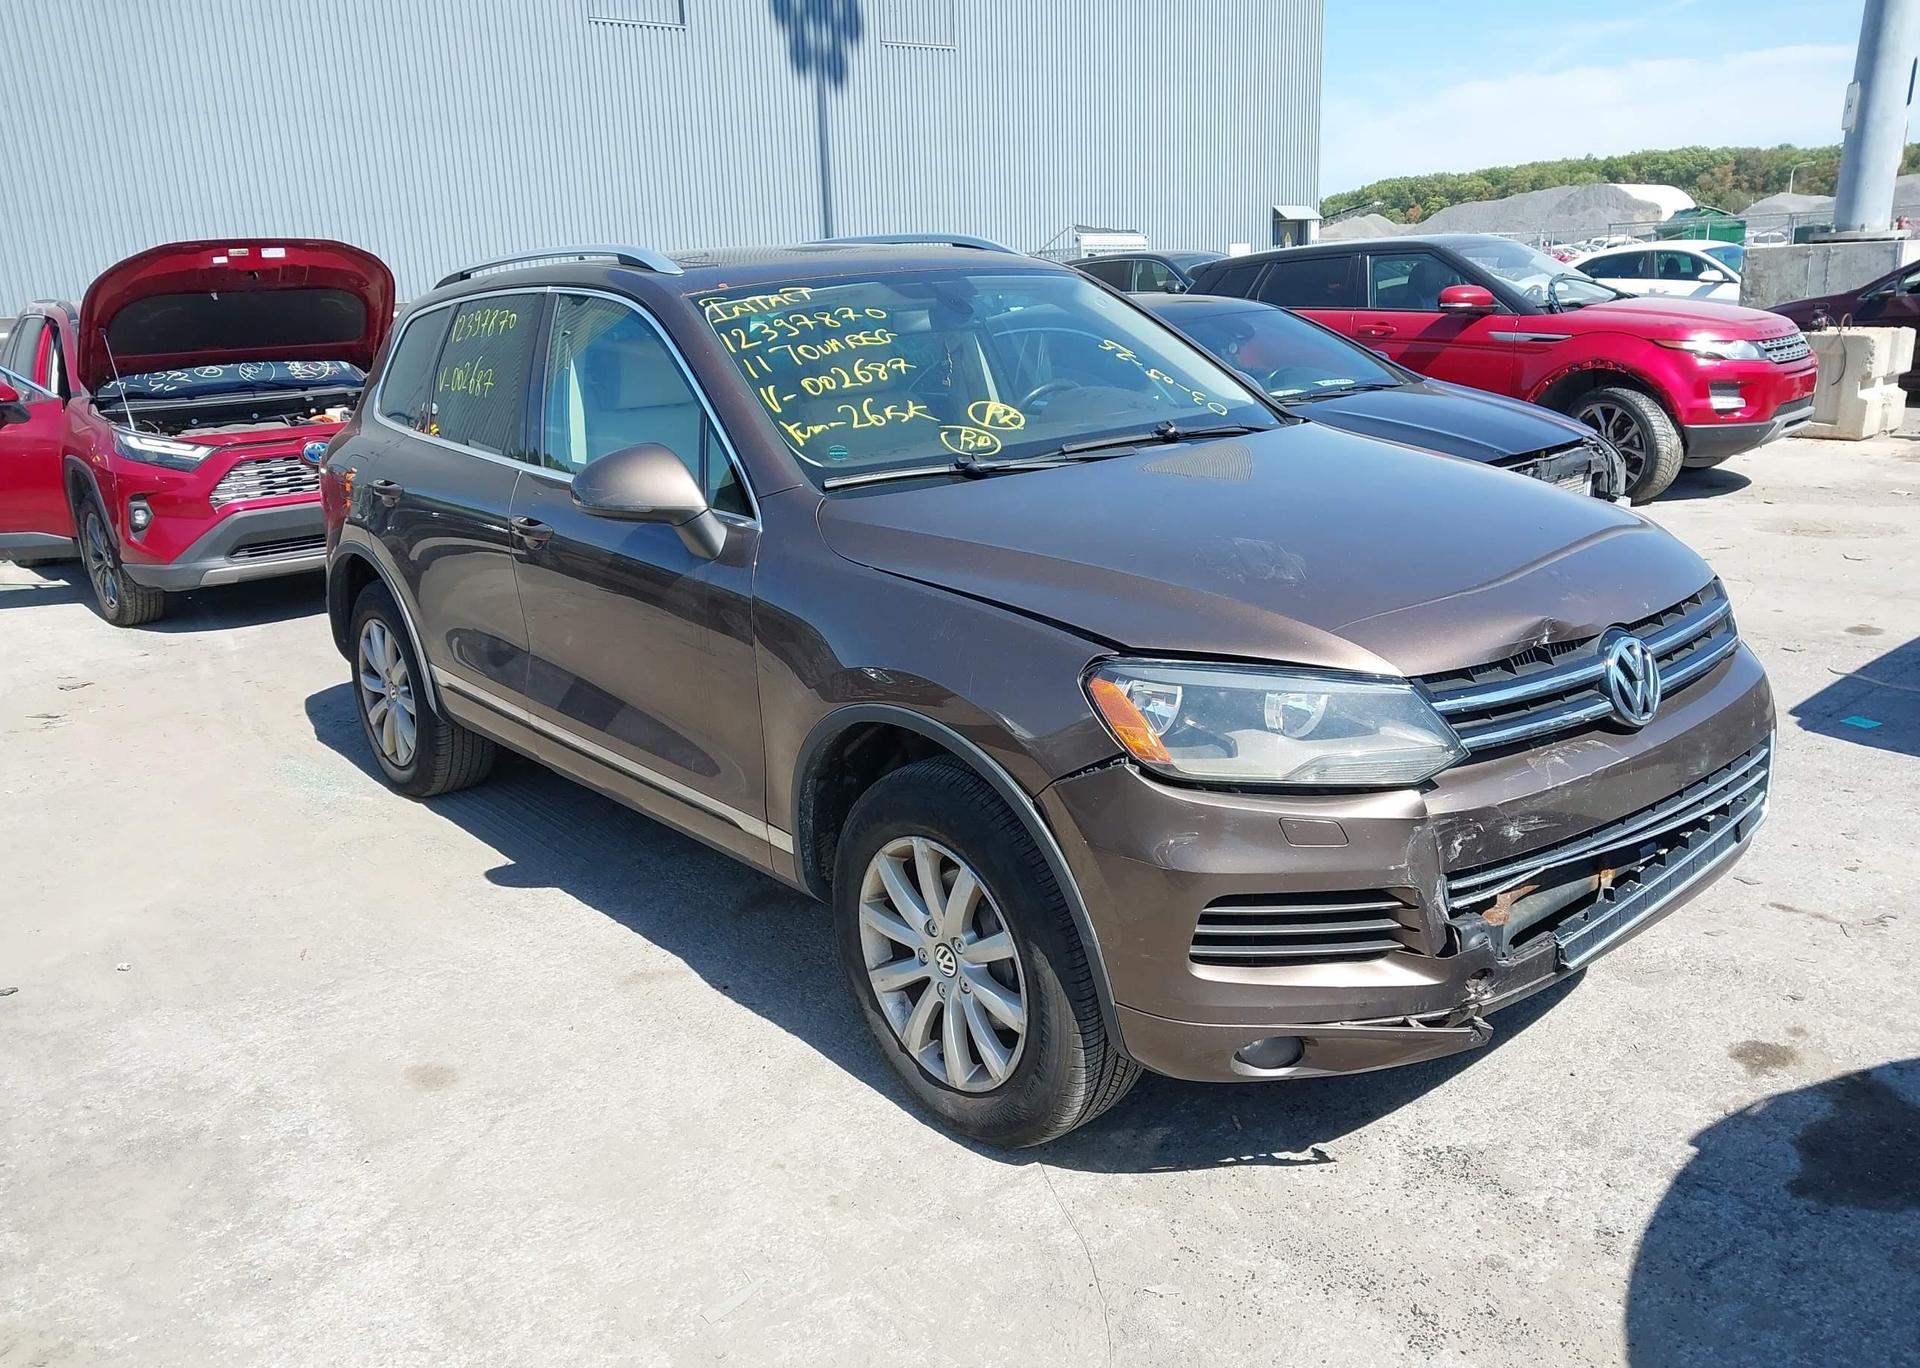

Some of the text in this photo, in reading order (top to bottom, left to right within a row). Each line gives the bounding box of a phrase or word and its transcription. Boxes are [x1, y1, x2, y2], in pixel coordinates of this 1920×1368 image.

[452, 309, 517, 343] 12397870
[720, 307, 887, 353] 12397870
[743, 355, 773, 379] 11
